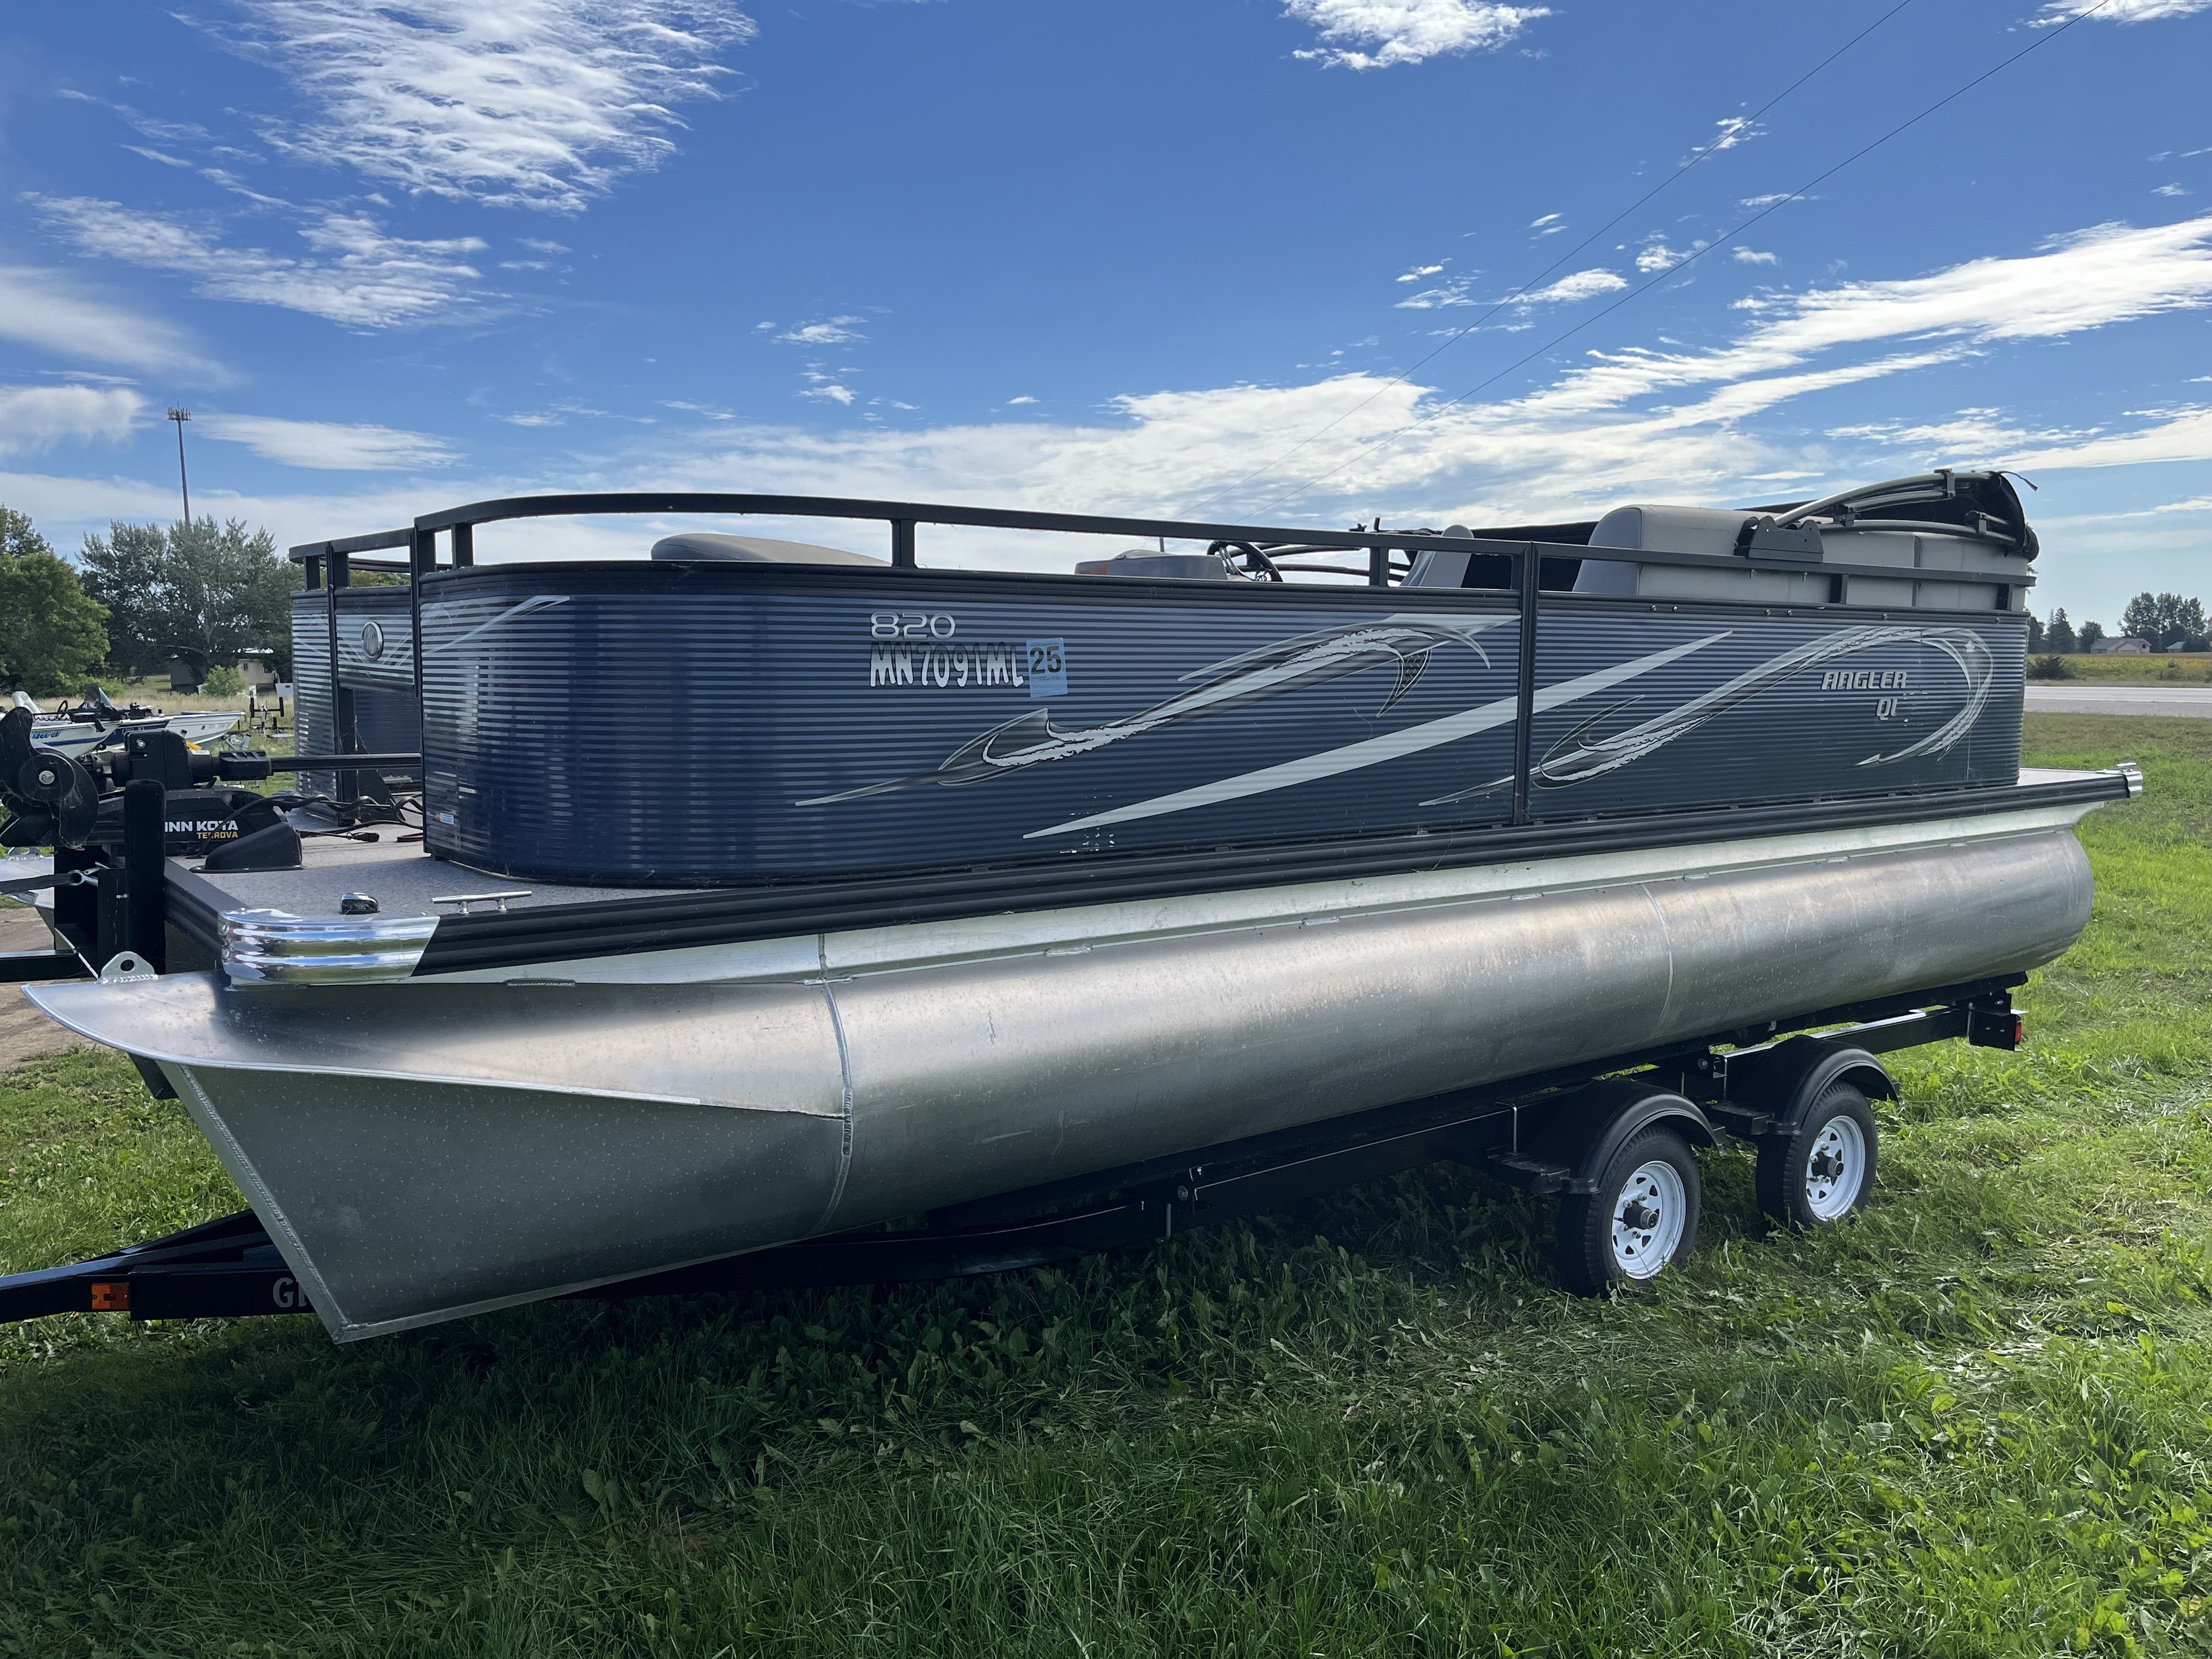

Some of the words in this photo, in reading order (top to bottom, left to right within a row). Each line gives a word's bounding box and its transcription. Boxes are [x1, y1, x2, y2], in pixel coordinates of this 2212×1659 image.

[871, 612, 956, 640] 820
[1029, 646, 1062, 675] 25
[1821, 671, 1907, 690] ANGLER
[165, 821, 193, 832] INN
